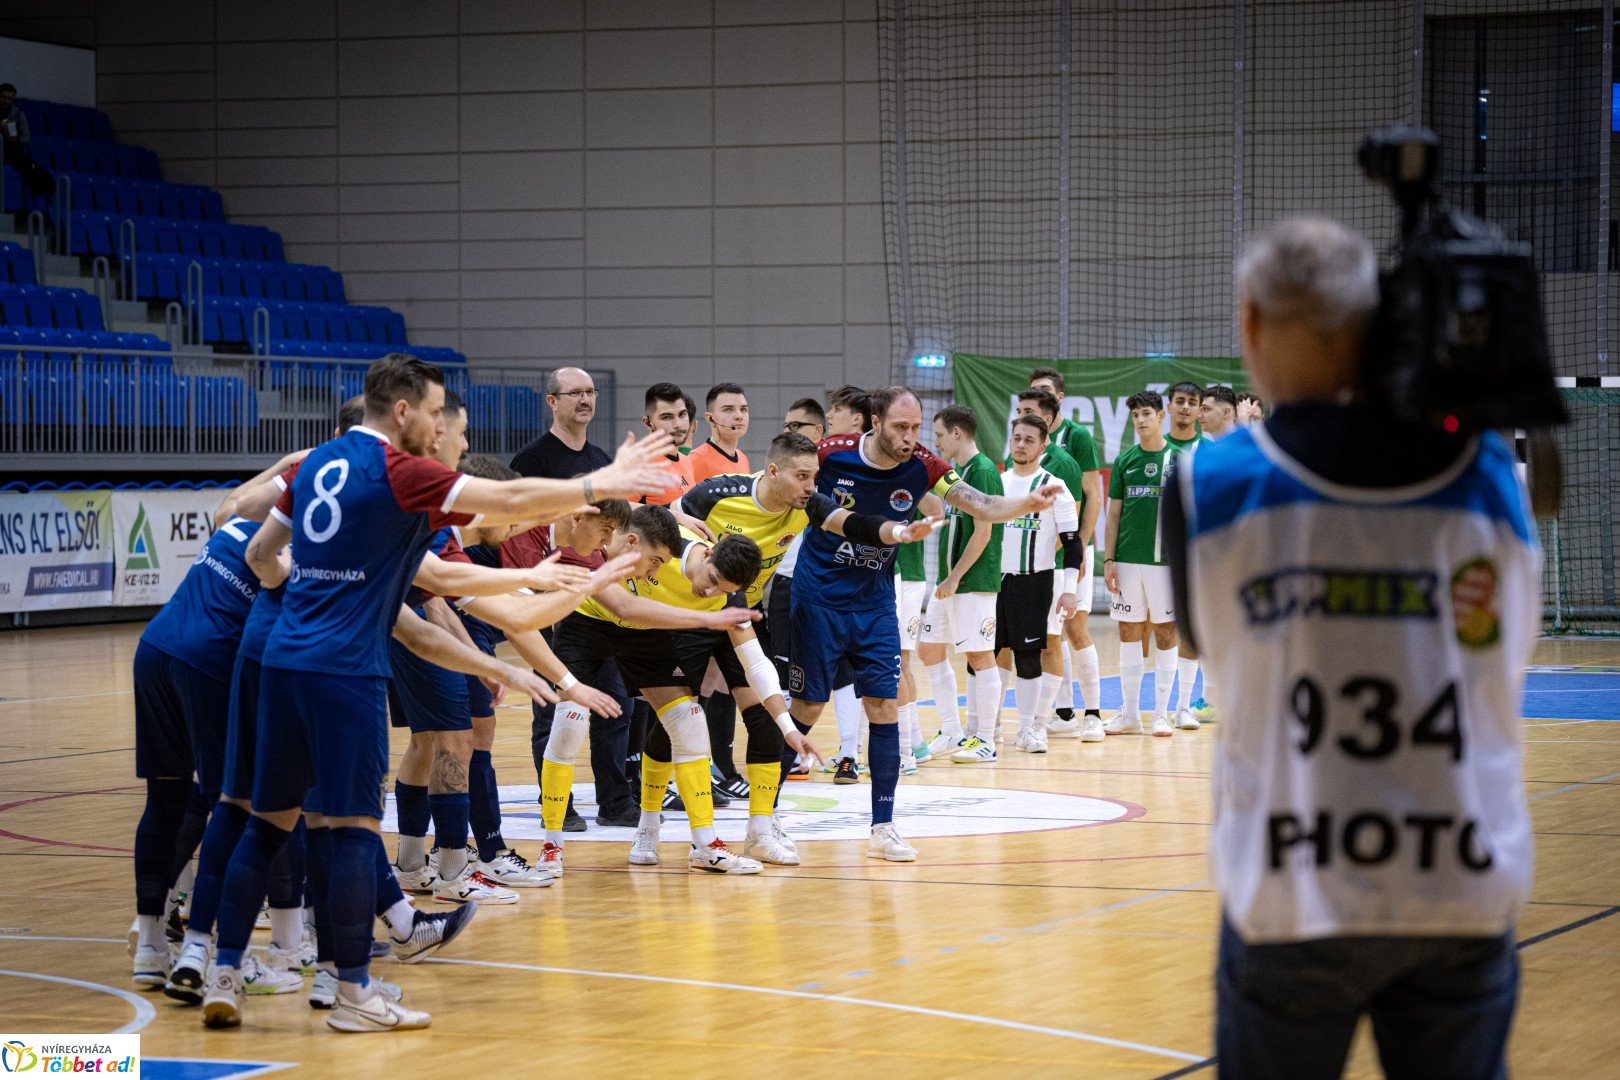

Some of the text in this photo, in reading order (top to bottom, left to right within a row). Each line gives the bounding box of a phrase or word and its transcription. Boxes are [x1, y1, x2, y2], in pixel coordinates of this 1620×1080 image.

[303, 458, 349, 543] 8
[837, 479, 854, 487] JAKO
[30, 512, 52, 554] AZ
[55, 500, 101, 553] ELSŐ!
[725, 523, 743, 533] JAKO
[204, 556, 256, 602] NYÍREGYHÁZA
[301, 566, 365, 581] NYÍREGYHÁZA
[1290, 673, 1463, 765] 934
[1269, 812, 1493, 873] PHOTO
